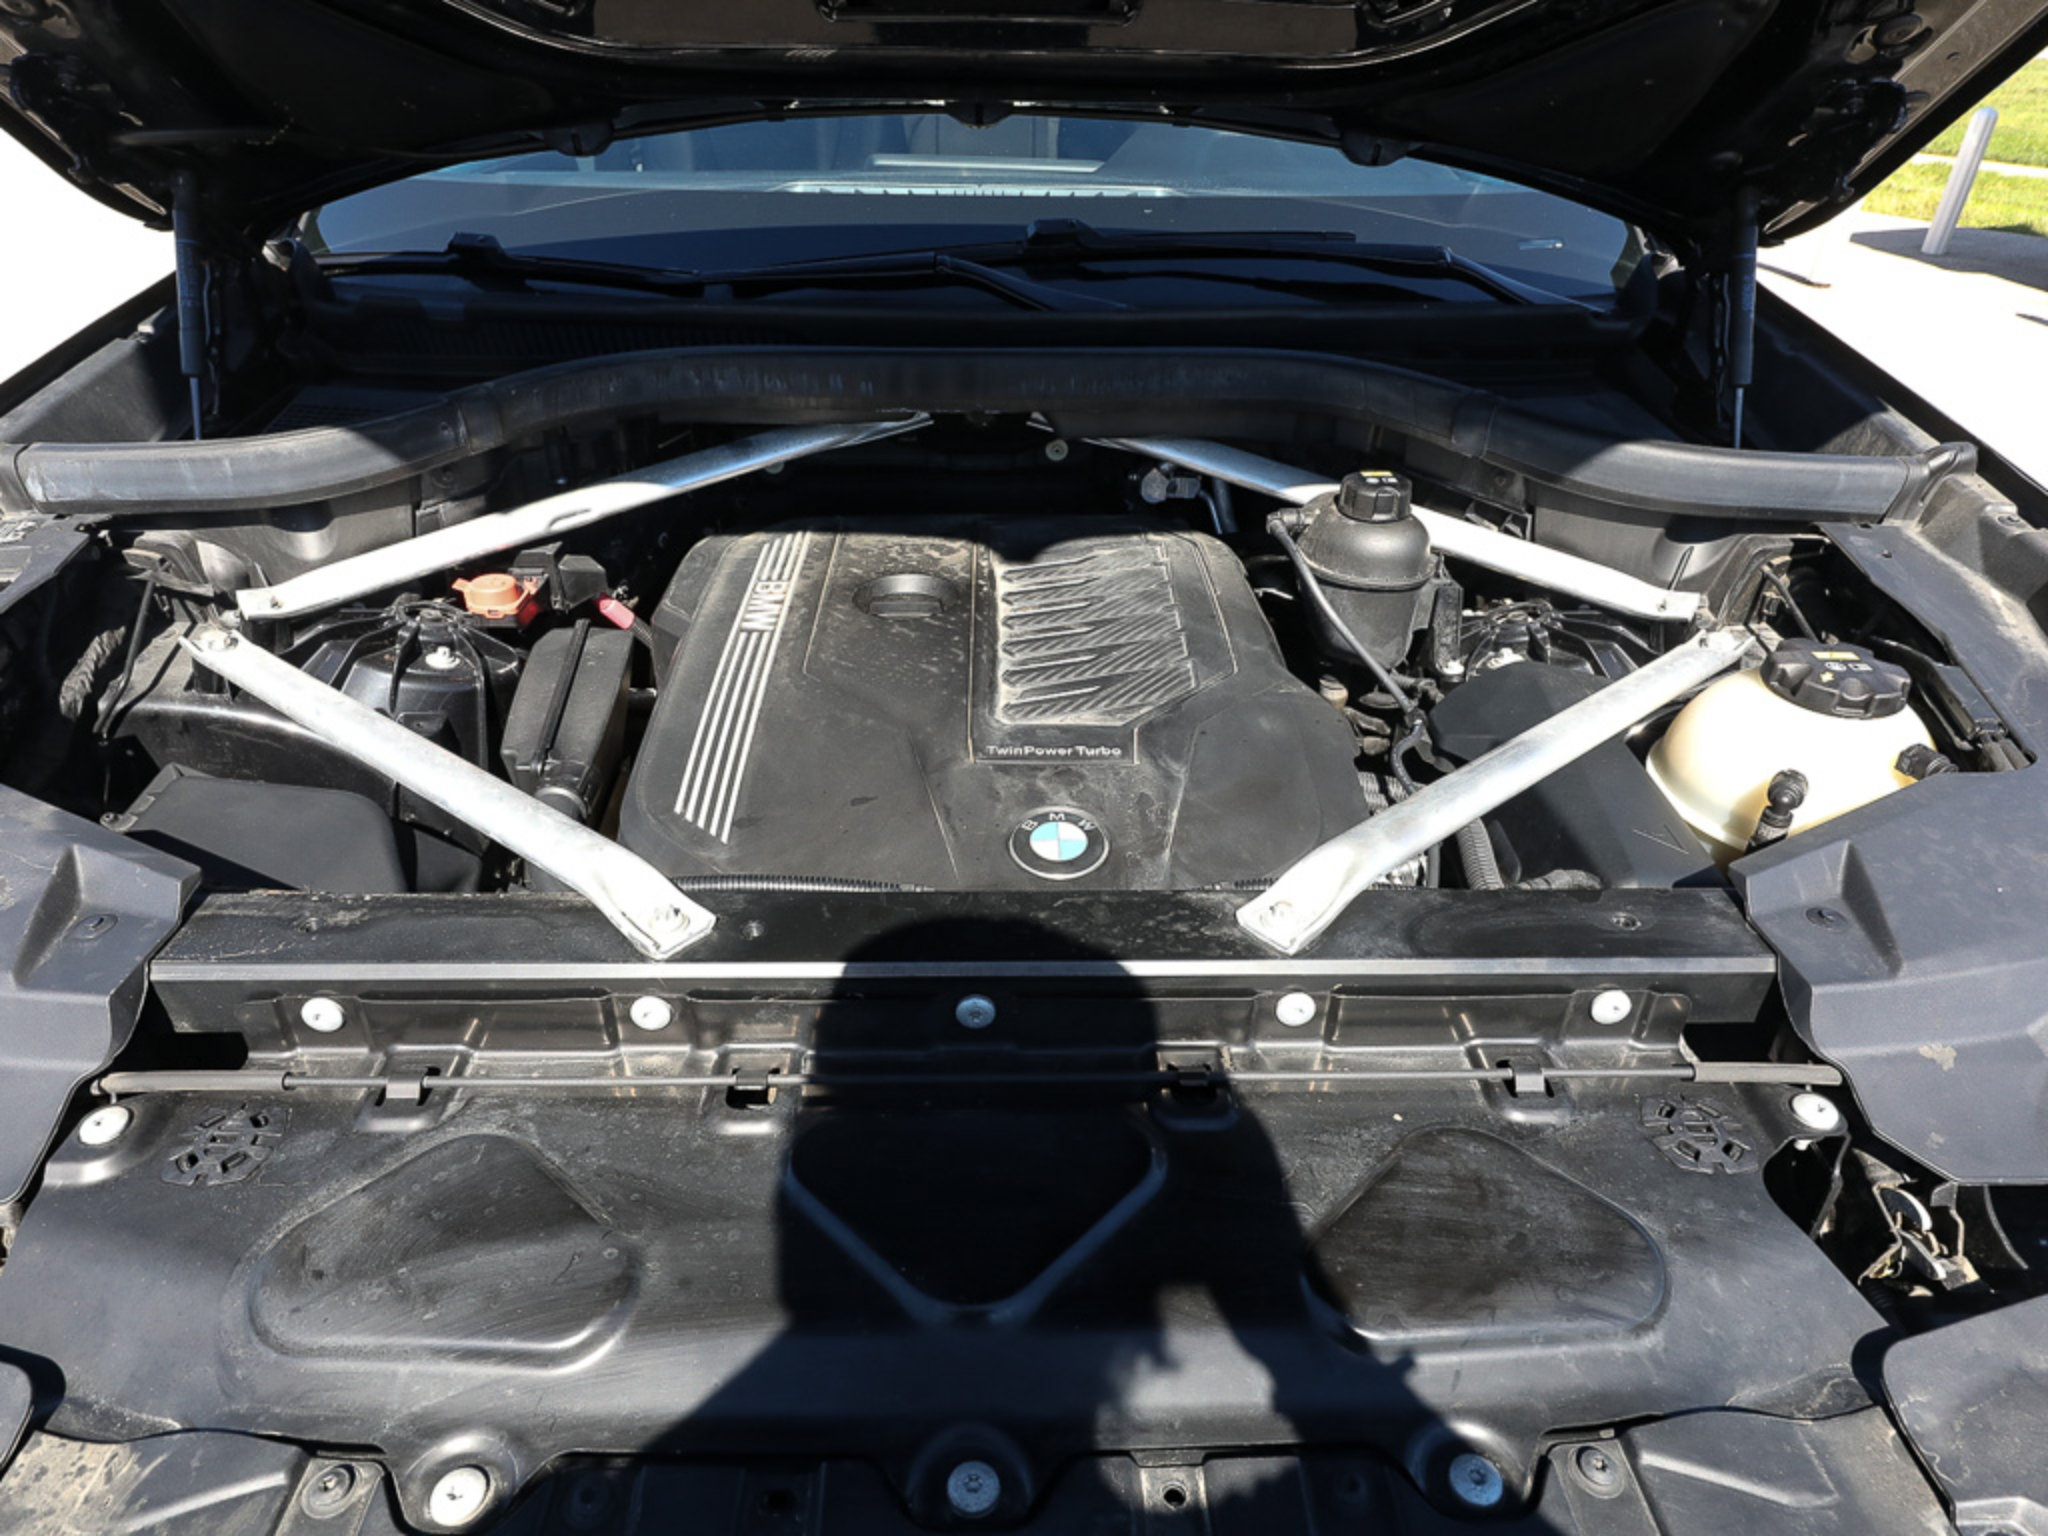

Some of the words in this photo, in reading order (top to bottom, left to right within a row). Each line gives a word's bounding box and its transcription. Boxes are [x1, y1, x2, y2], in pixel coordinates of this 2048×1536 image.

[739, 580, 791, 632] BMW
[1074, 745, 1122, 756] Turbo
[1021, 812, 1097, 831] BMW
